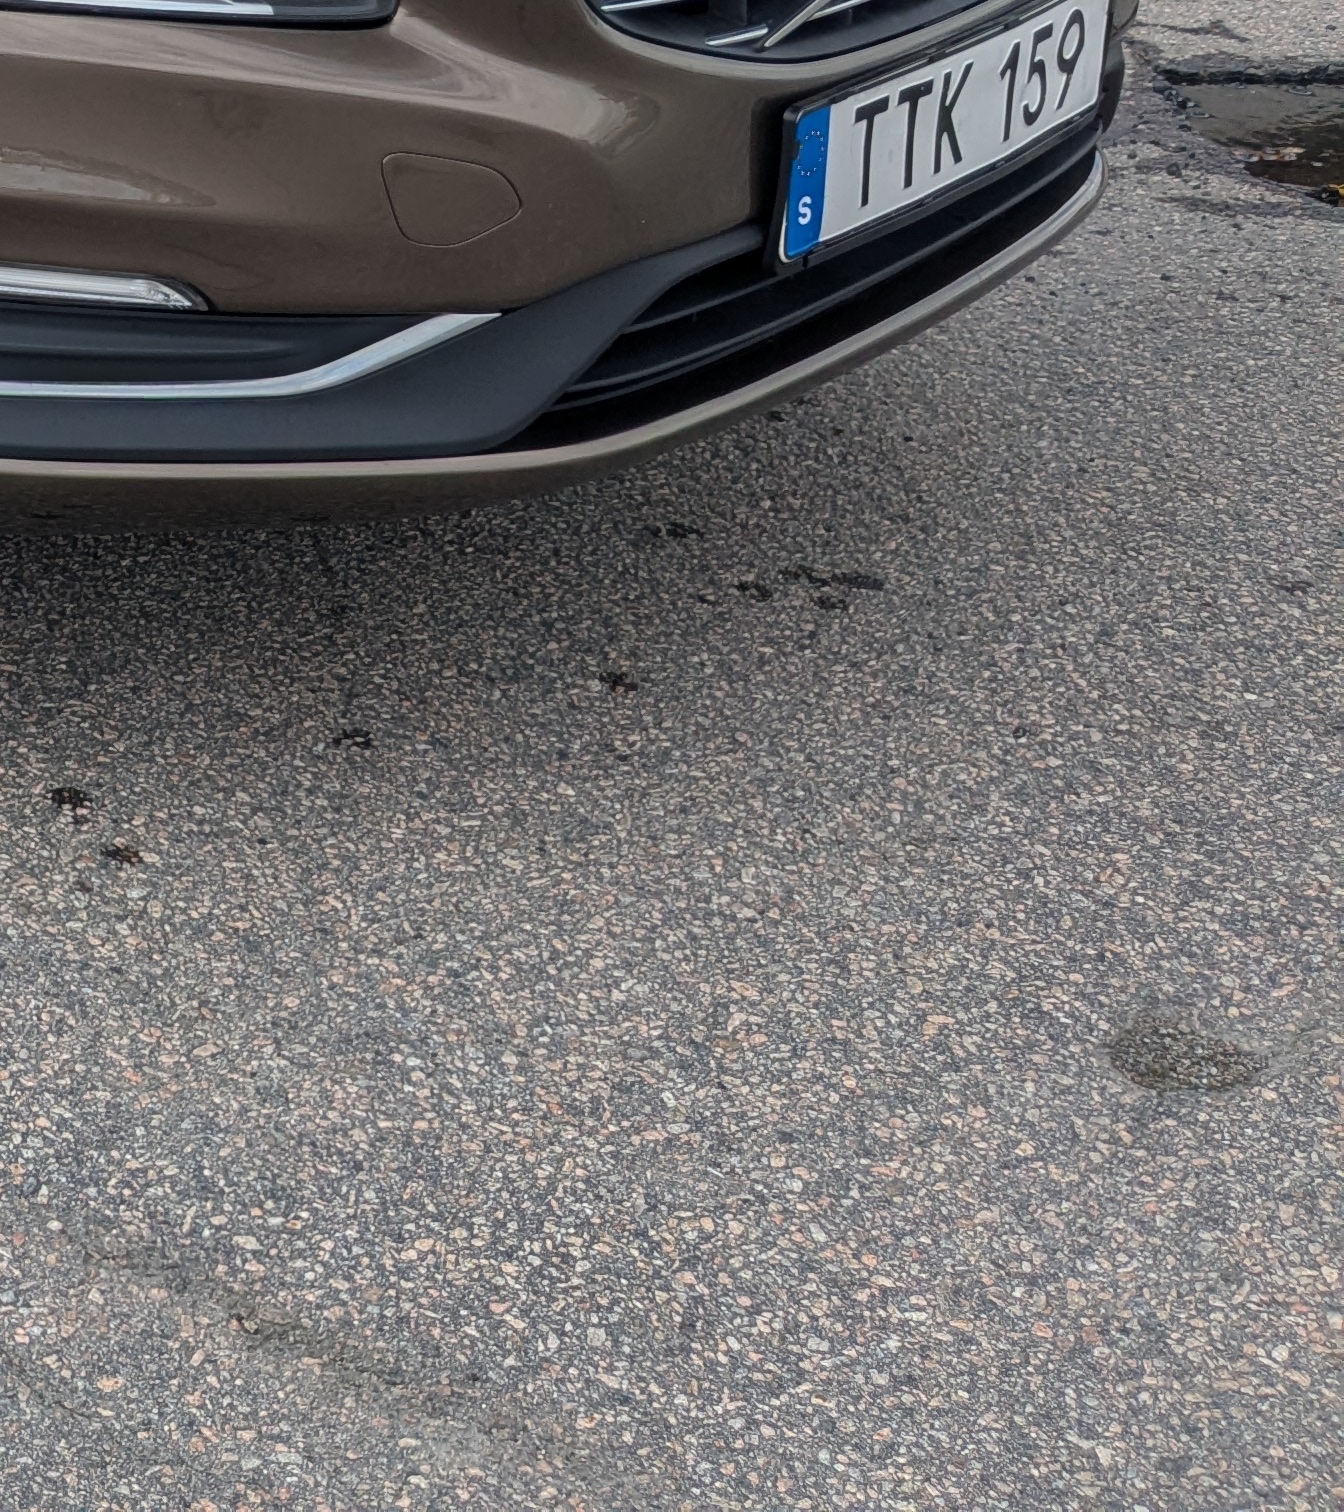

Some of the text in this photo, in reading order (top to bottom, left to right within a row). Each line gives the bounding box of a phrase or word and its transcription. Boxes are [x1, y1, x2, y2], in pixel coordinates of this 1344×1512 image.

[853, 8, 1087, 208] TTK 159
[796, 195, 812, 226] S
